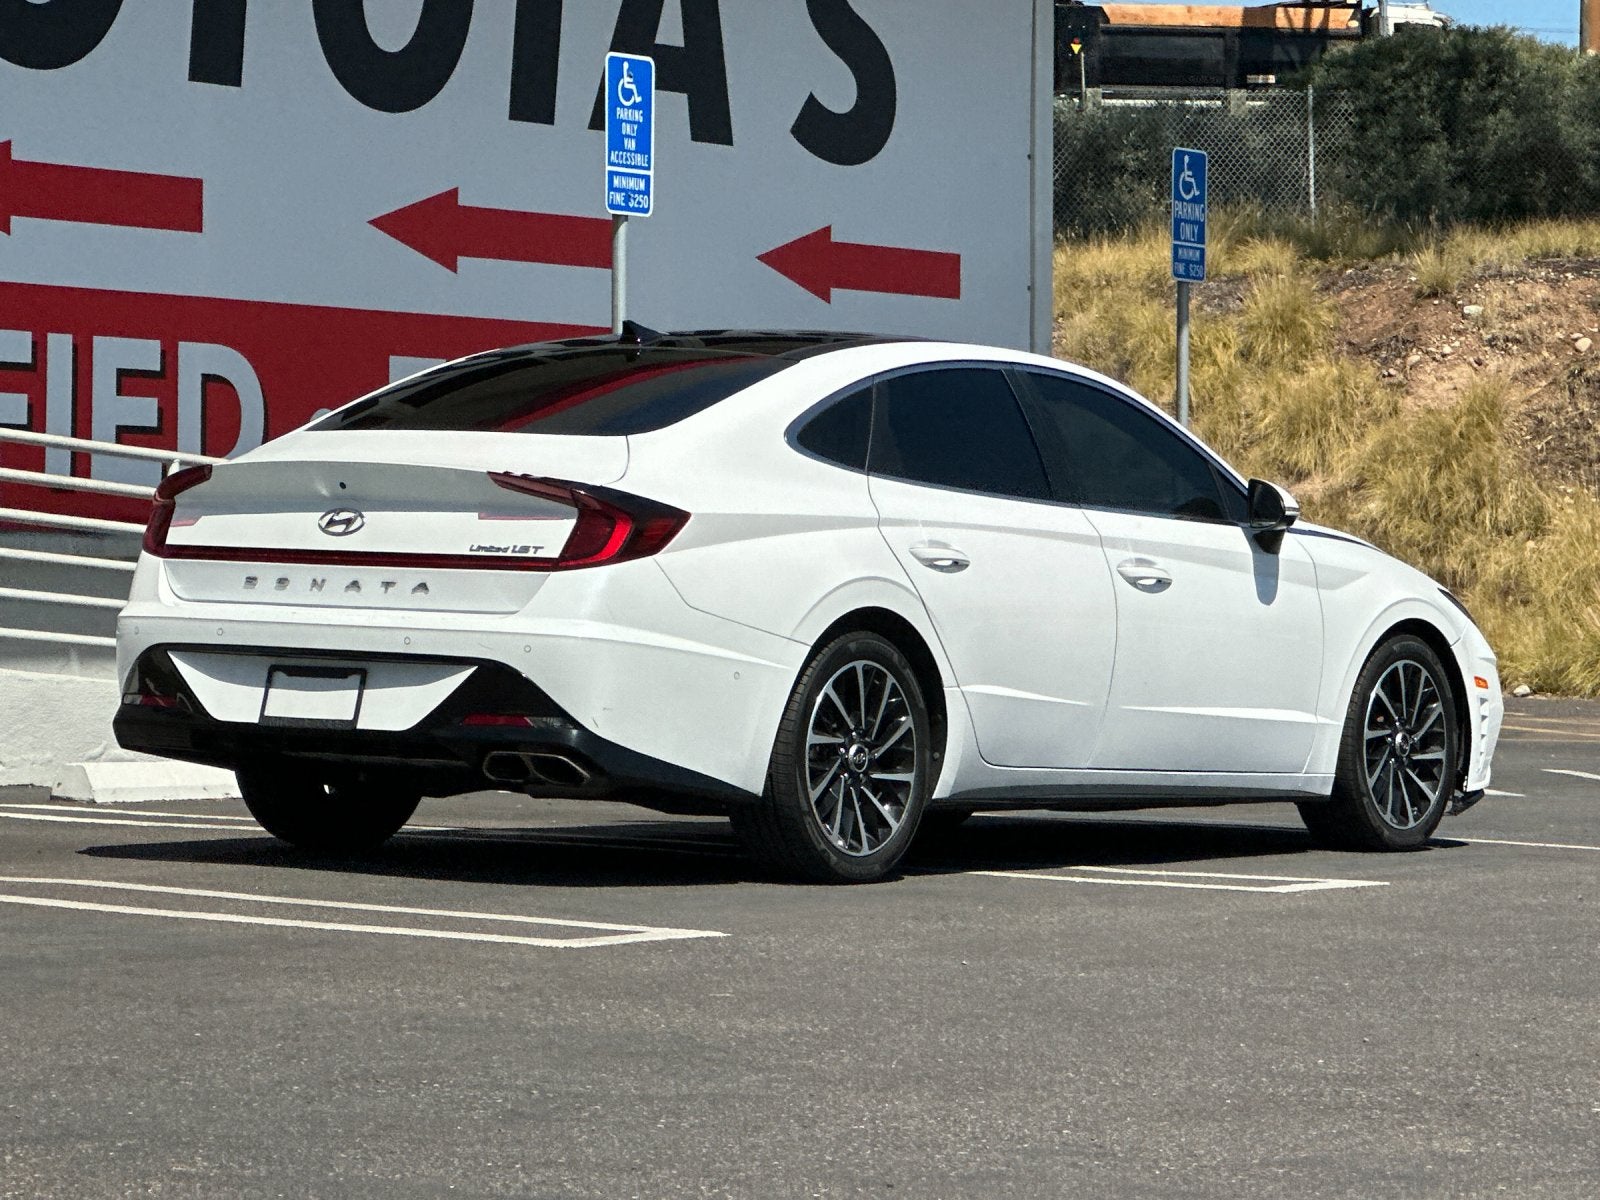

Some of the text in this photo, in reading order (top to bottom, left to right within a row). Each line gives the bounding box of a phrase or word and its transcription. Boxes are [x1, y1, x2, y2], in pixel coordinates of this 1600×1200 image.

[616, 107, 643, 123] PARKING
[621, 122, 638, 136] ONLY
[623, 137, 636, 150] VAN
[610, 150, 649, 167] ACCESSIBLE
[613, 175, 645, 191] MINIMUM
[608, 191, 649, 209] FINE $250
[1174, 200, 1204, 222] PARKING
[1180, 222, 1198, 241] ONLY
[1178, 247, 1200, 261] MINIMUM
[1174, 262, 1185, 275] FINE
